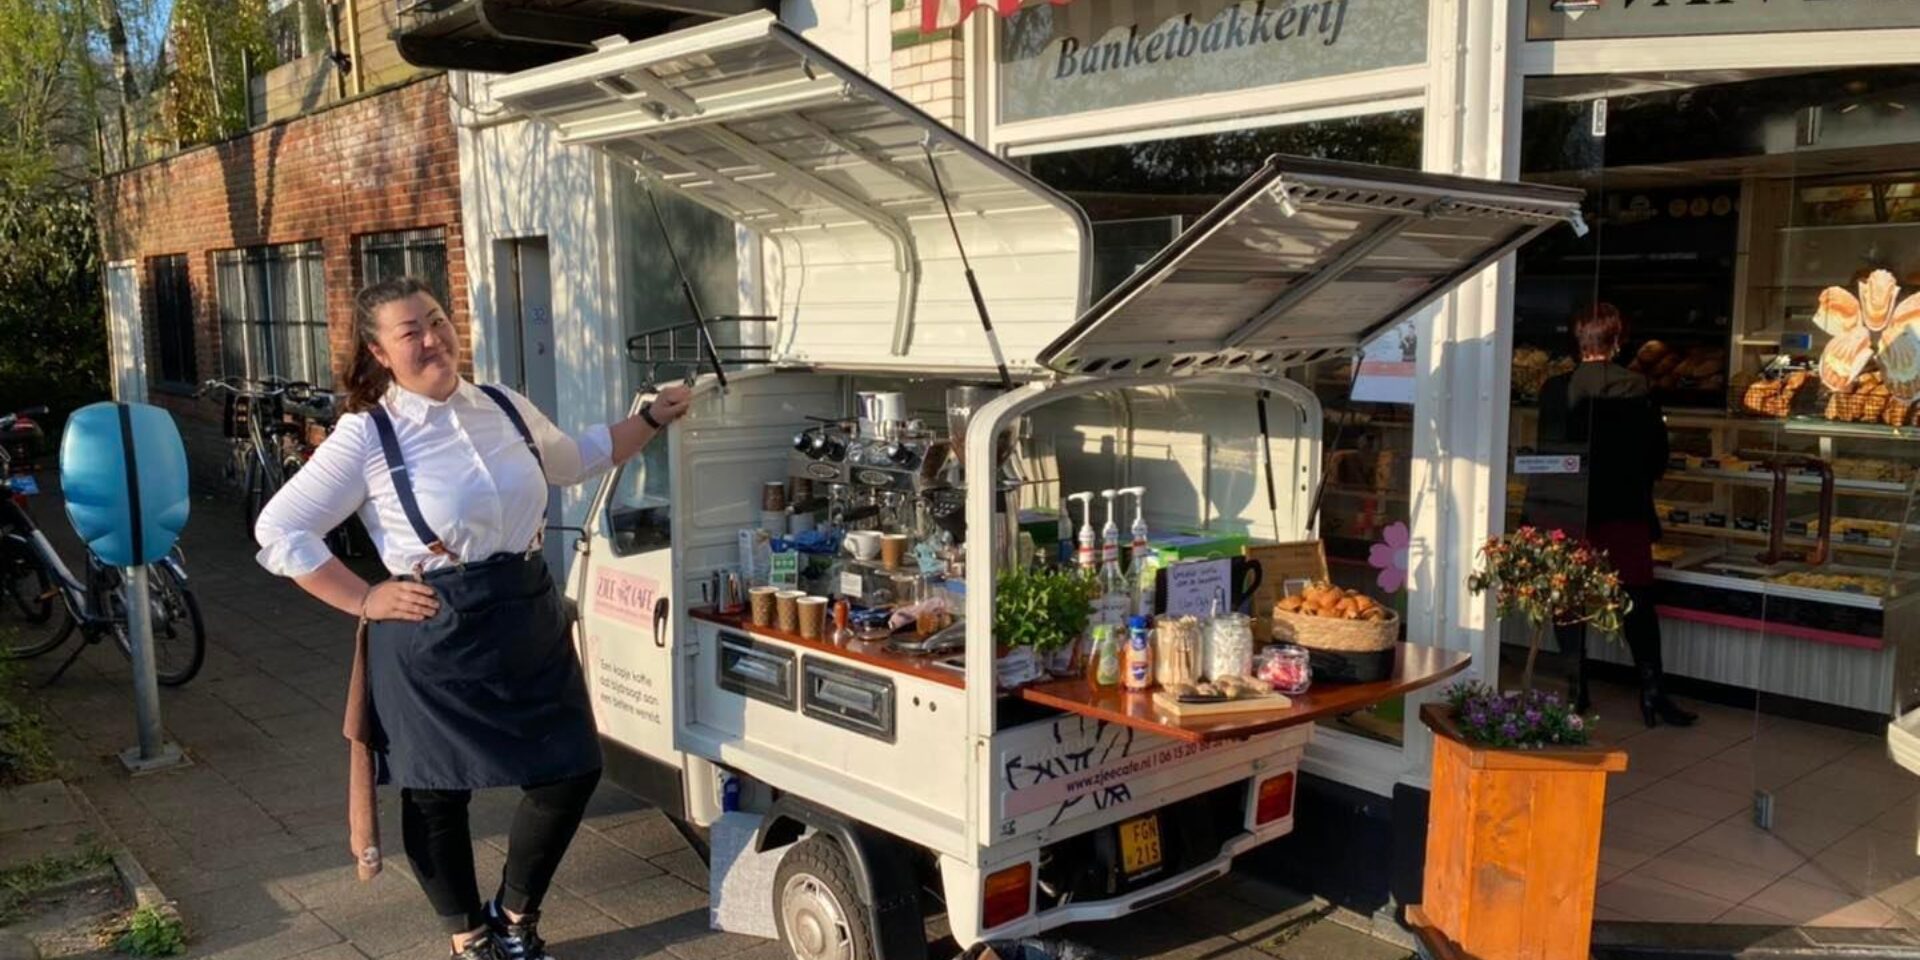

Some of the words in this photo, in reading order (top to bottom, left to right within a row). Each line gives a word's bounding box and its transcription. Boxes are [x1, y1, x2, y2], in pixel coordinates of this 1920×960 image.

[1055, 0, 1349, 79] Banketbakkerij
[1066, 758, 1151, 792] www.zjeecafe.nl
[1134, 820, 1157, 843] FGN
